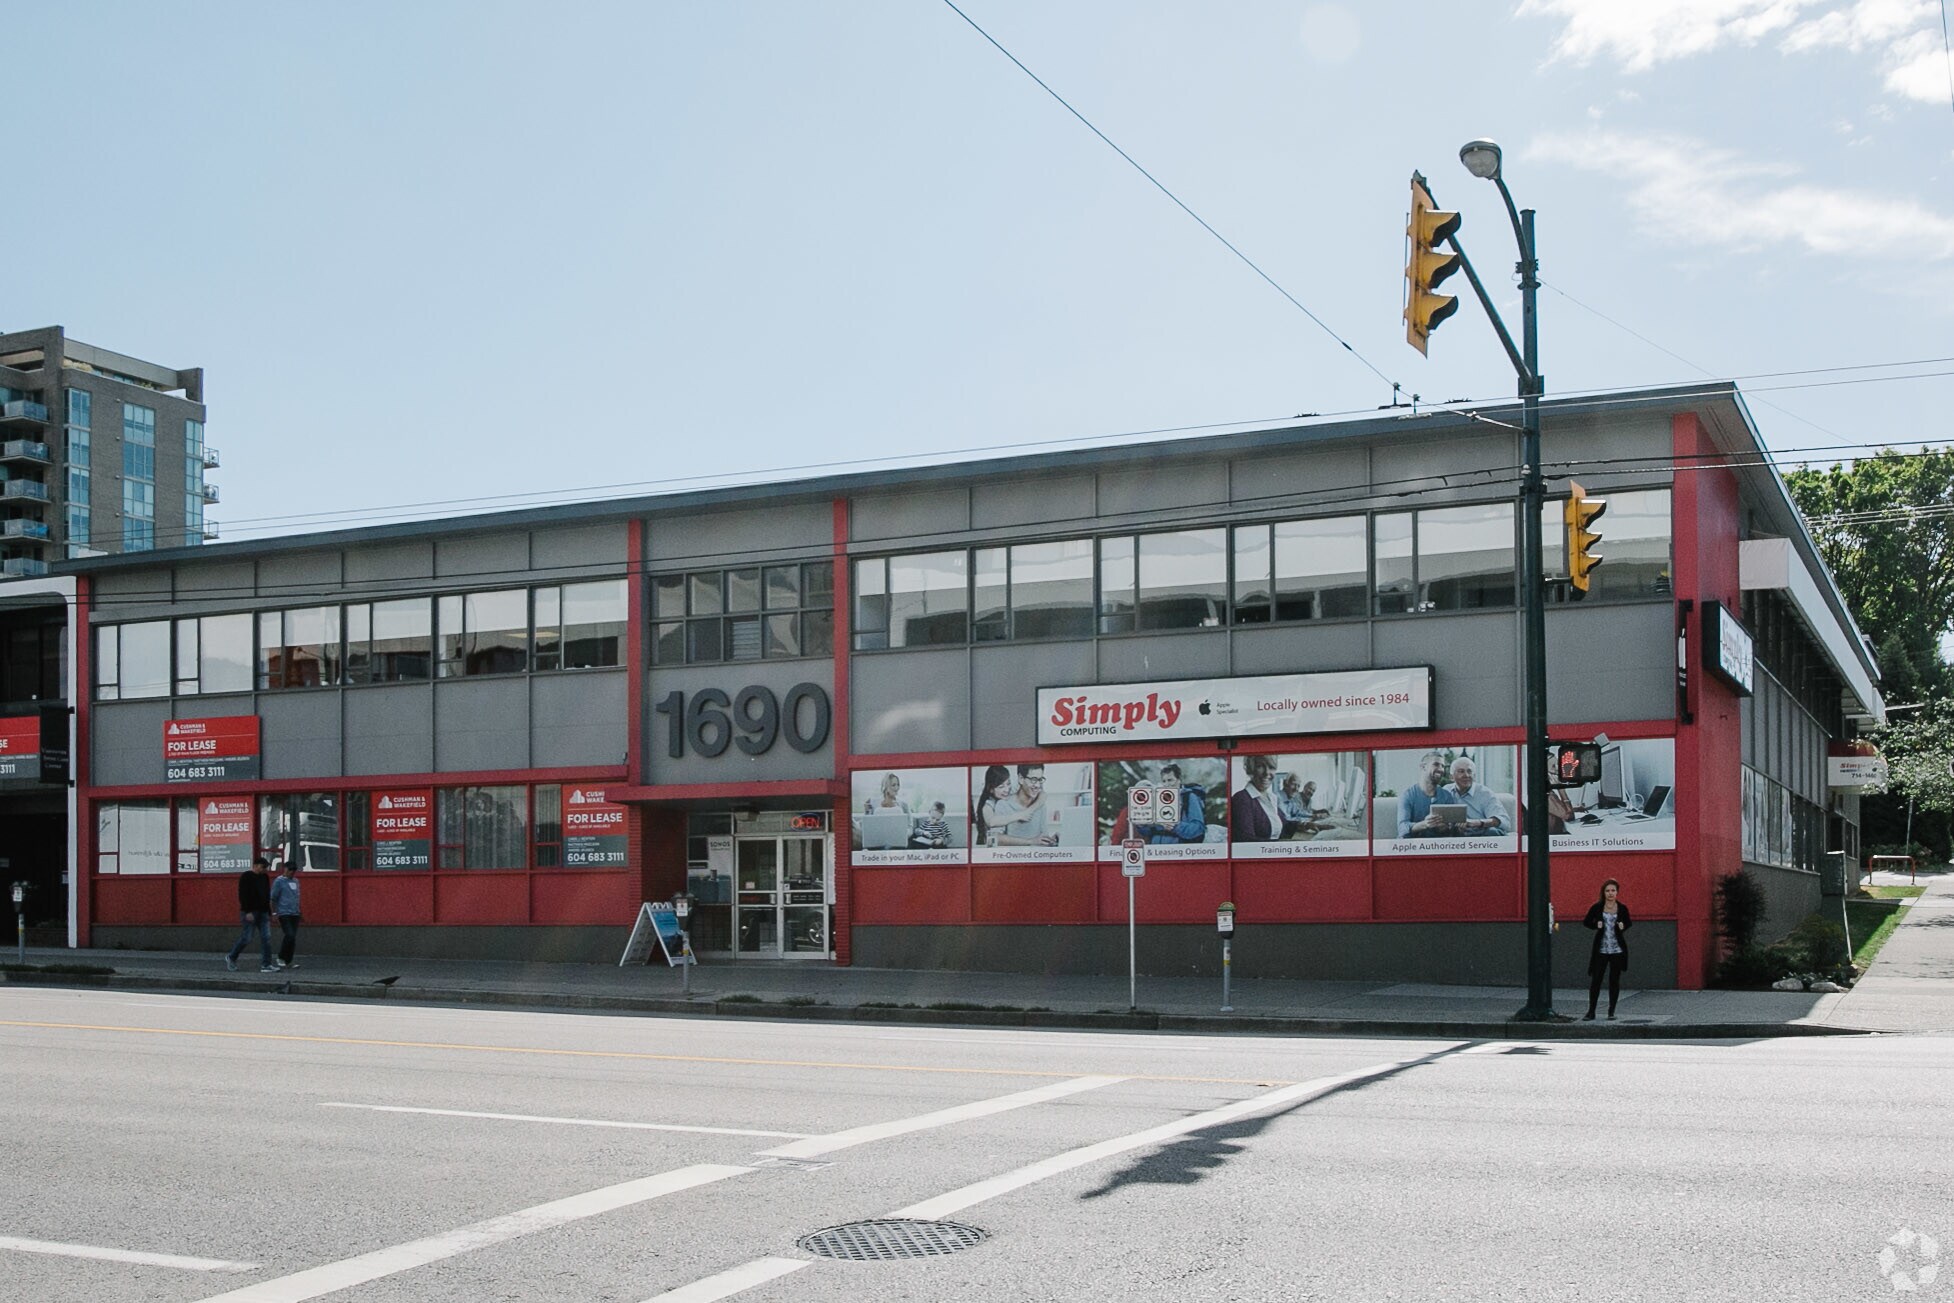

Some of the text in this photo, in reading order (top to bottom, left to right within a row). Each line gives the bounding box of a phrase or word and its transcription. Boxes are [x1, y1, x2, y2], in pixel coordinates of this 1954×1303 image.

[1257, 693, 1409, 712] Locally owned since 1984
[1052, 692, 1182, 730] Simply
[656, 682, 832, 758] 1690
[1060, 726, 1116, 736] COMPUTING
[168, 740, 216, 752] FOR LEASE
[0, 764, 16, 774] 3111
[168, 766, 225, 778] 604 683 3111
[376, 817, 426, 828] FOR LEASE
[568, 813, 622, 823] FOR LEASE
[790, 816, 820, 828] OPEN
[203, 822, 249, 832] FOR LEASE
[1392, 840, 1498, 852] Apple Authorized Service
[1552, 839, 1589, 847] Business
[1602, 837, 1644, 846] Solutions
[1154, 848, 1183, 857] Leasing
[1186, 847, 1216, 856] Options
[1260, 846, 1292, 855] Training
[1303, 845, 1339, 853] Seminars
[377, 856, 428, 865] 604 683 3111
[568, 852, 624, 862] 604 683 3111
[861, 854, 879, 862] Trade
[889, 855, 905, 864] your
[907, 854, 922, 862] Mac,
[924, 853, 938, 861] iPad
[1034, 851, 1073, 860] Computers
[236, 859, 250, 868] 3111
